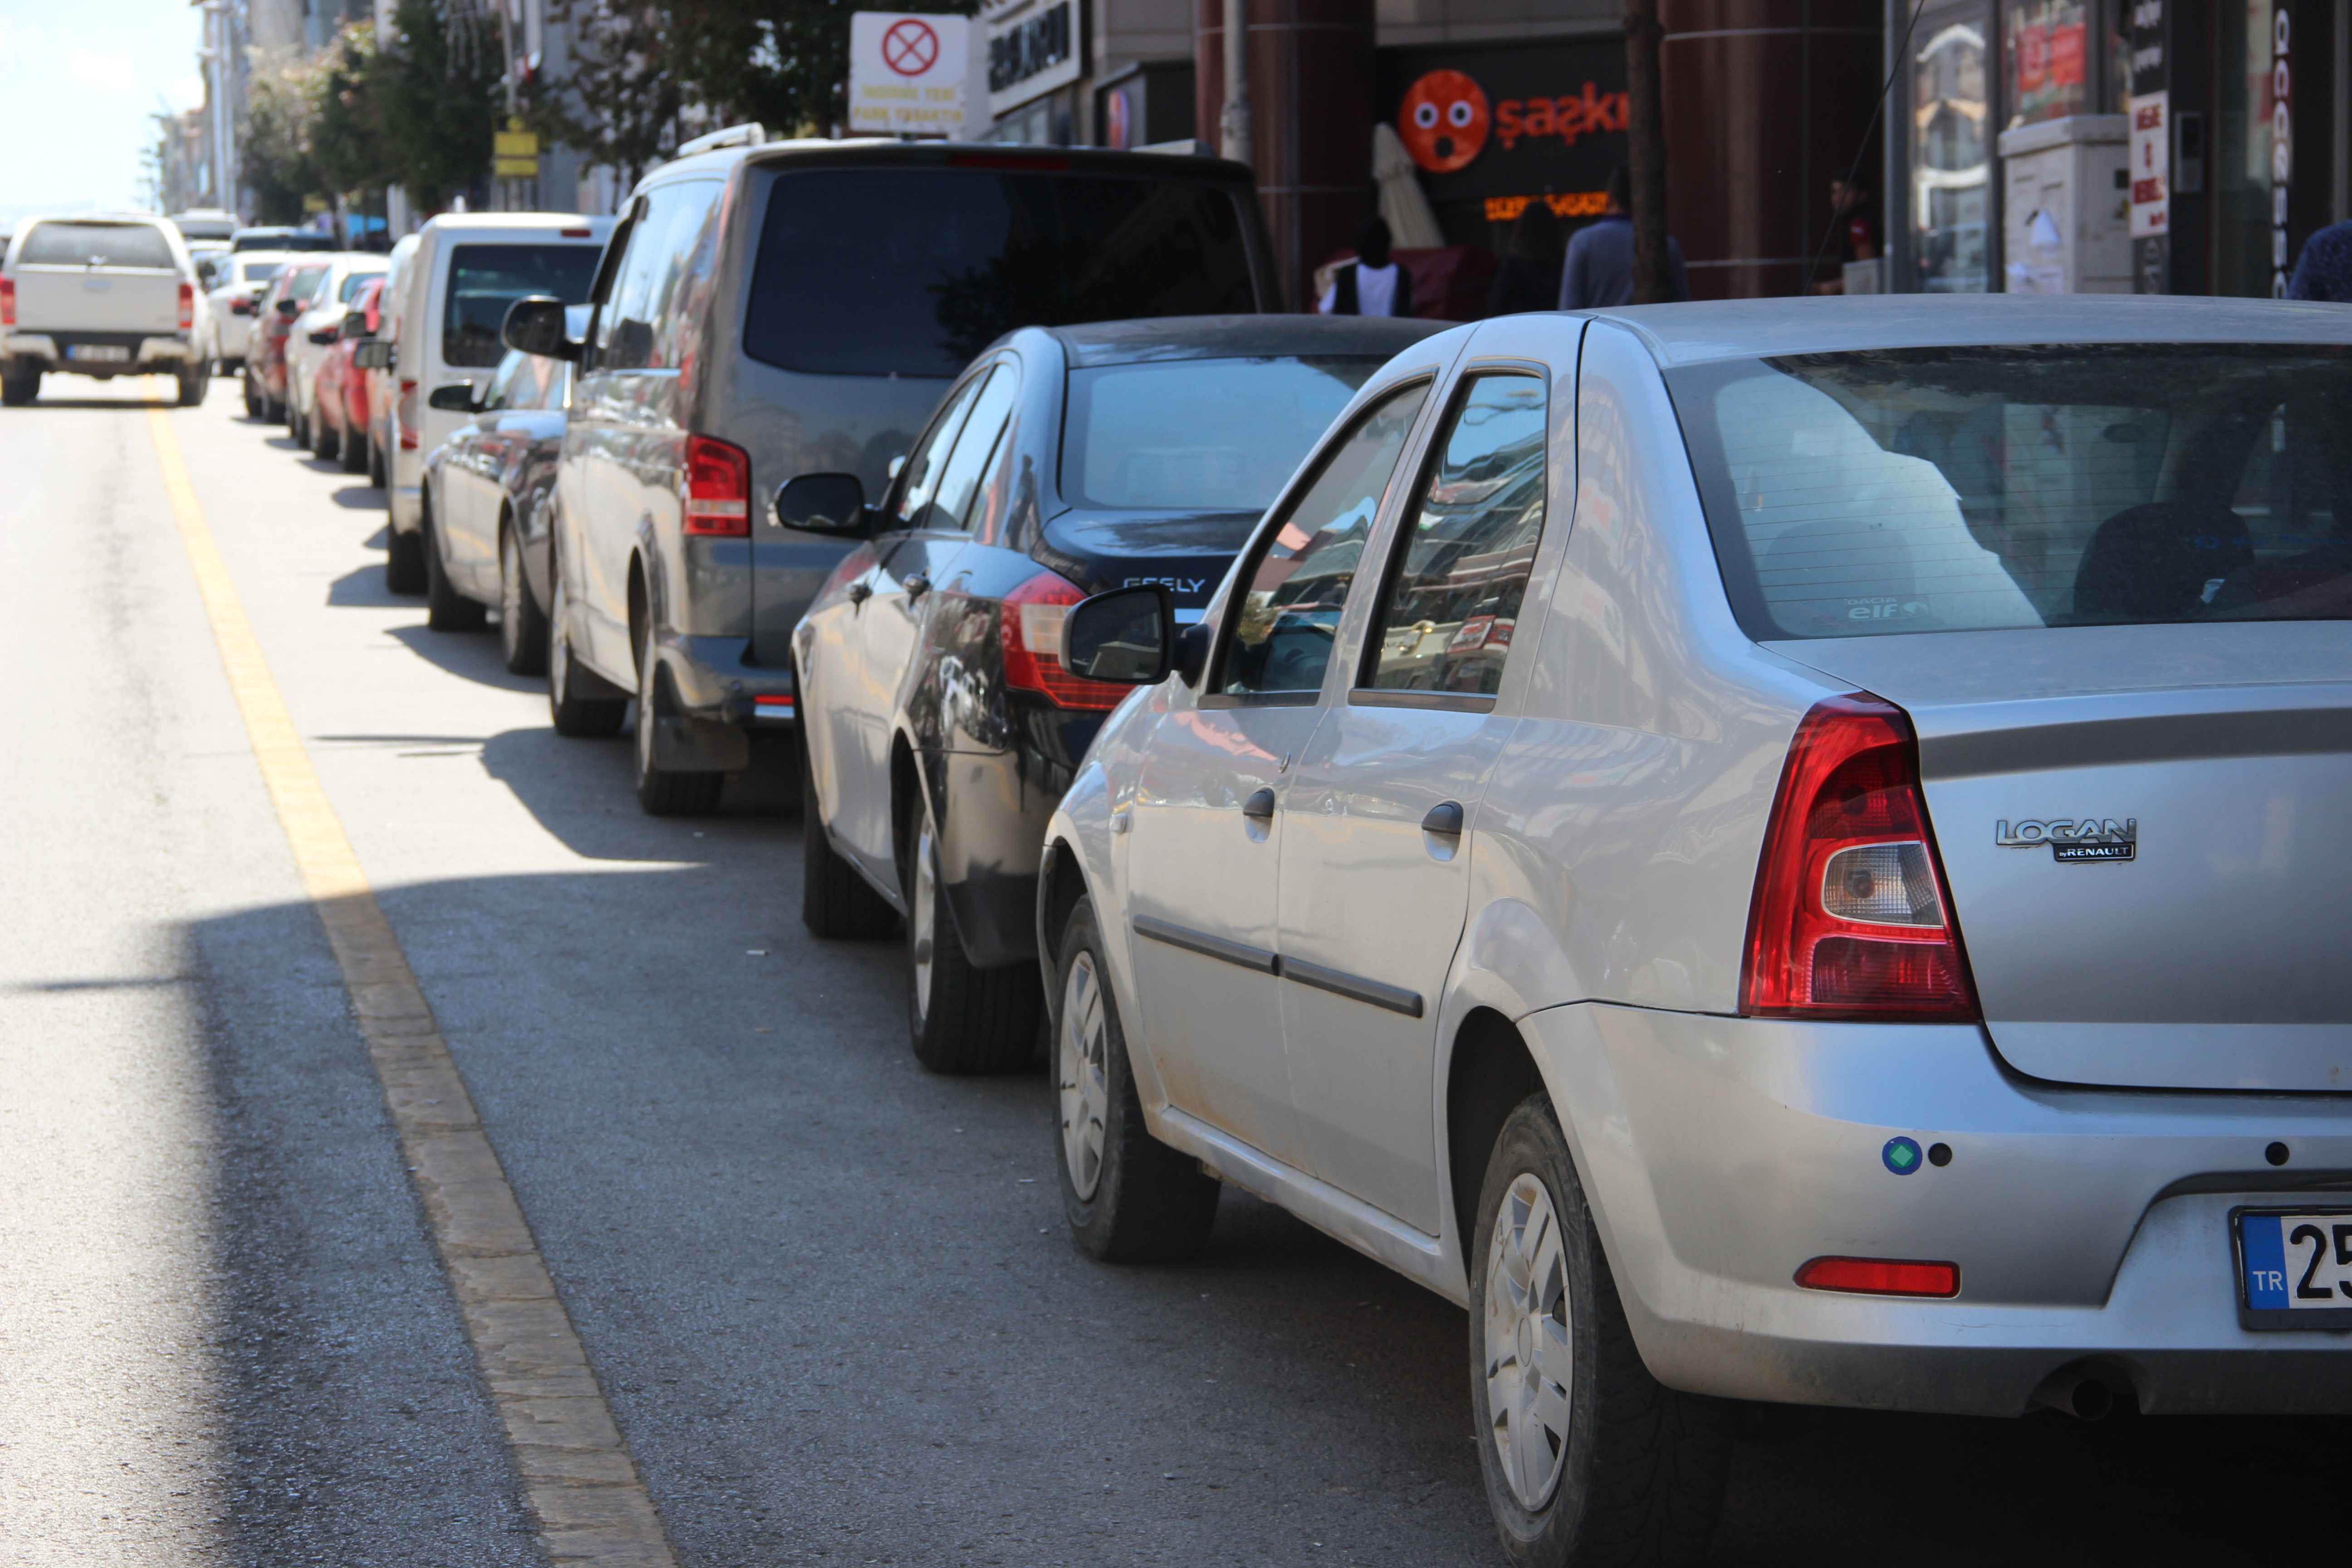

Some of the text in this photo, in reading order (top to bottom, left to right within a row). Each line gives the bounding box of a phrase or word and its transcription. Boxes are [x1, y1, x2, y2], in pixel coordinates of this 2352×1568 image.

[853, 106, 964, 122] PARK YASAKTIR
[1496, 80, 1630, 149] şaşkı
[1847, 597, 1897, 605] DACIA
[1848, 604, 1898, 619] elf
[1997, 818, 2136, 845] LOGAN
[2067, 847, 2129, 856] RENAULT
[2253, 1271, 2283, 1291] TR
